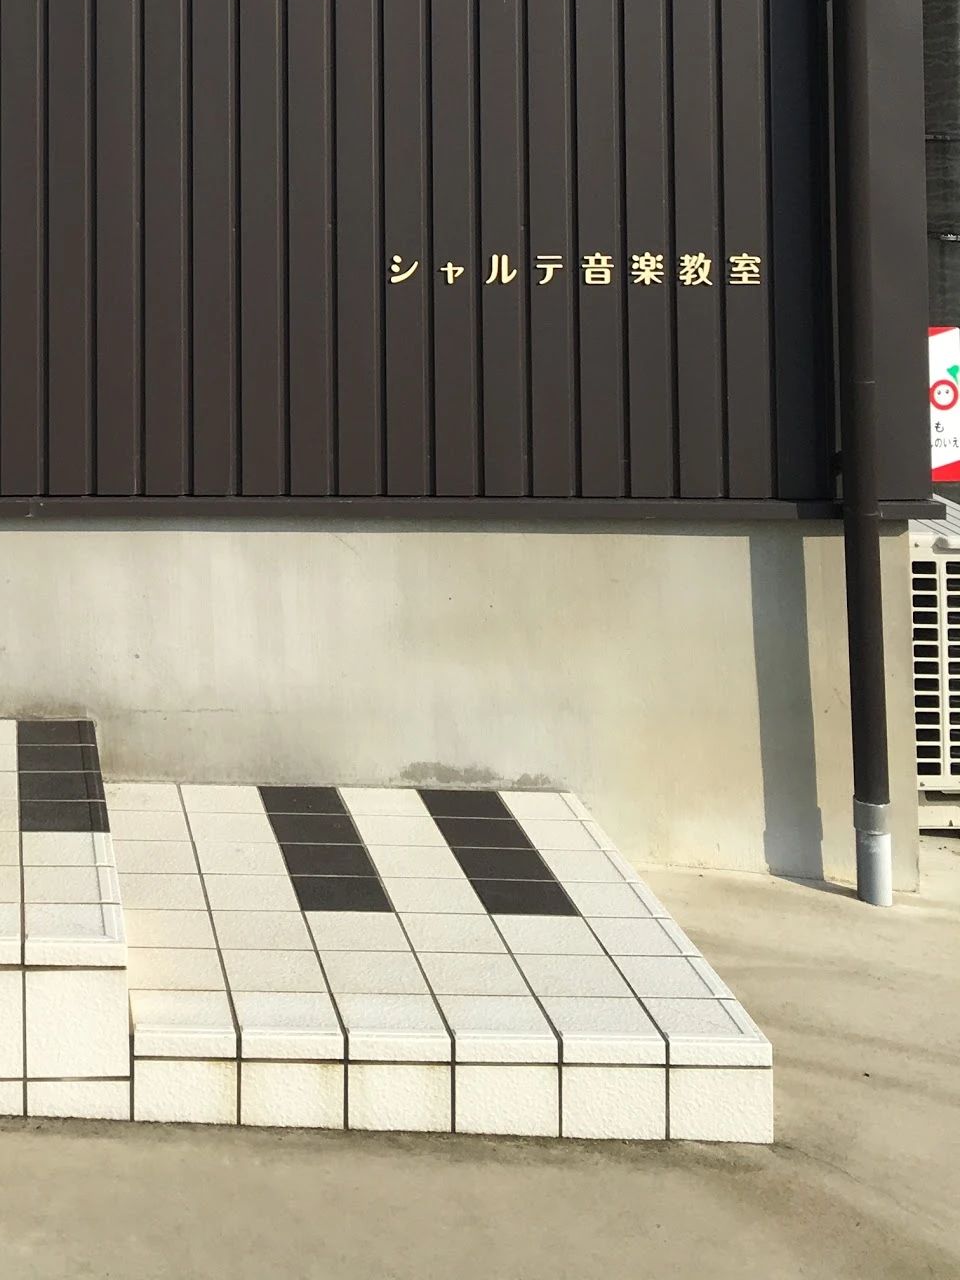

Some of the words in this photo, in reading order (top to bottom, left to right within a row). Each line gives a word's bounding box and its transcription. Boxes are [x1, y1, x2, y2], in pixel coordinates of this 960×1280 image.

[390, 252, 762, 286] シャルテ音楽教室
[930, 437, 959, 449] のいえ
